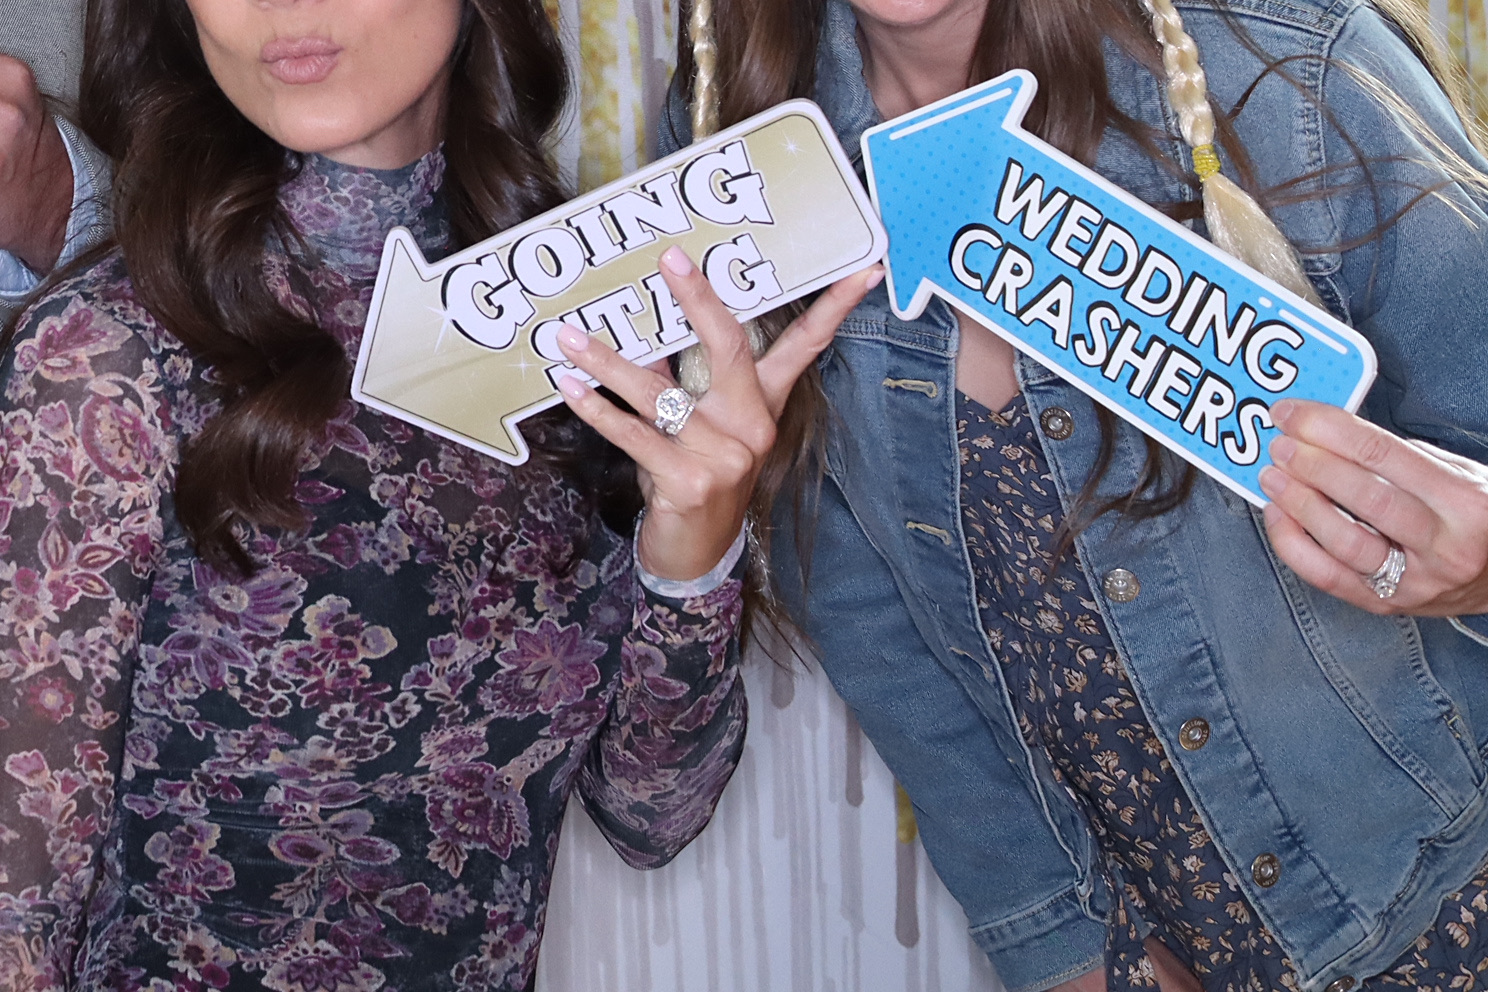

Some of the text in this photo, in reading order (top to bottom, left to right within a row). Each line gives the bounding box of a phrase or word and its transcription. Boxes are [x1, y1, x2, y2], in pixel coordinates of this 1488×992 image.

[441, 140, 774, 349] GOING
[948, 223, 1275, 466] CRASHERS
[995, 157, 1305, 393] WEDDING
